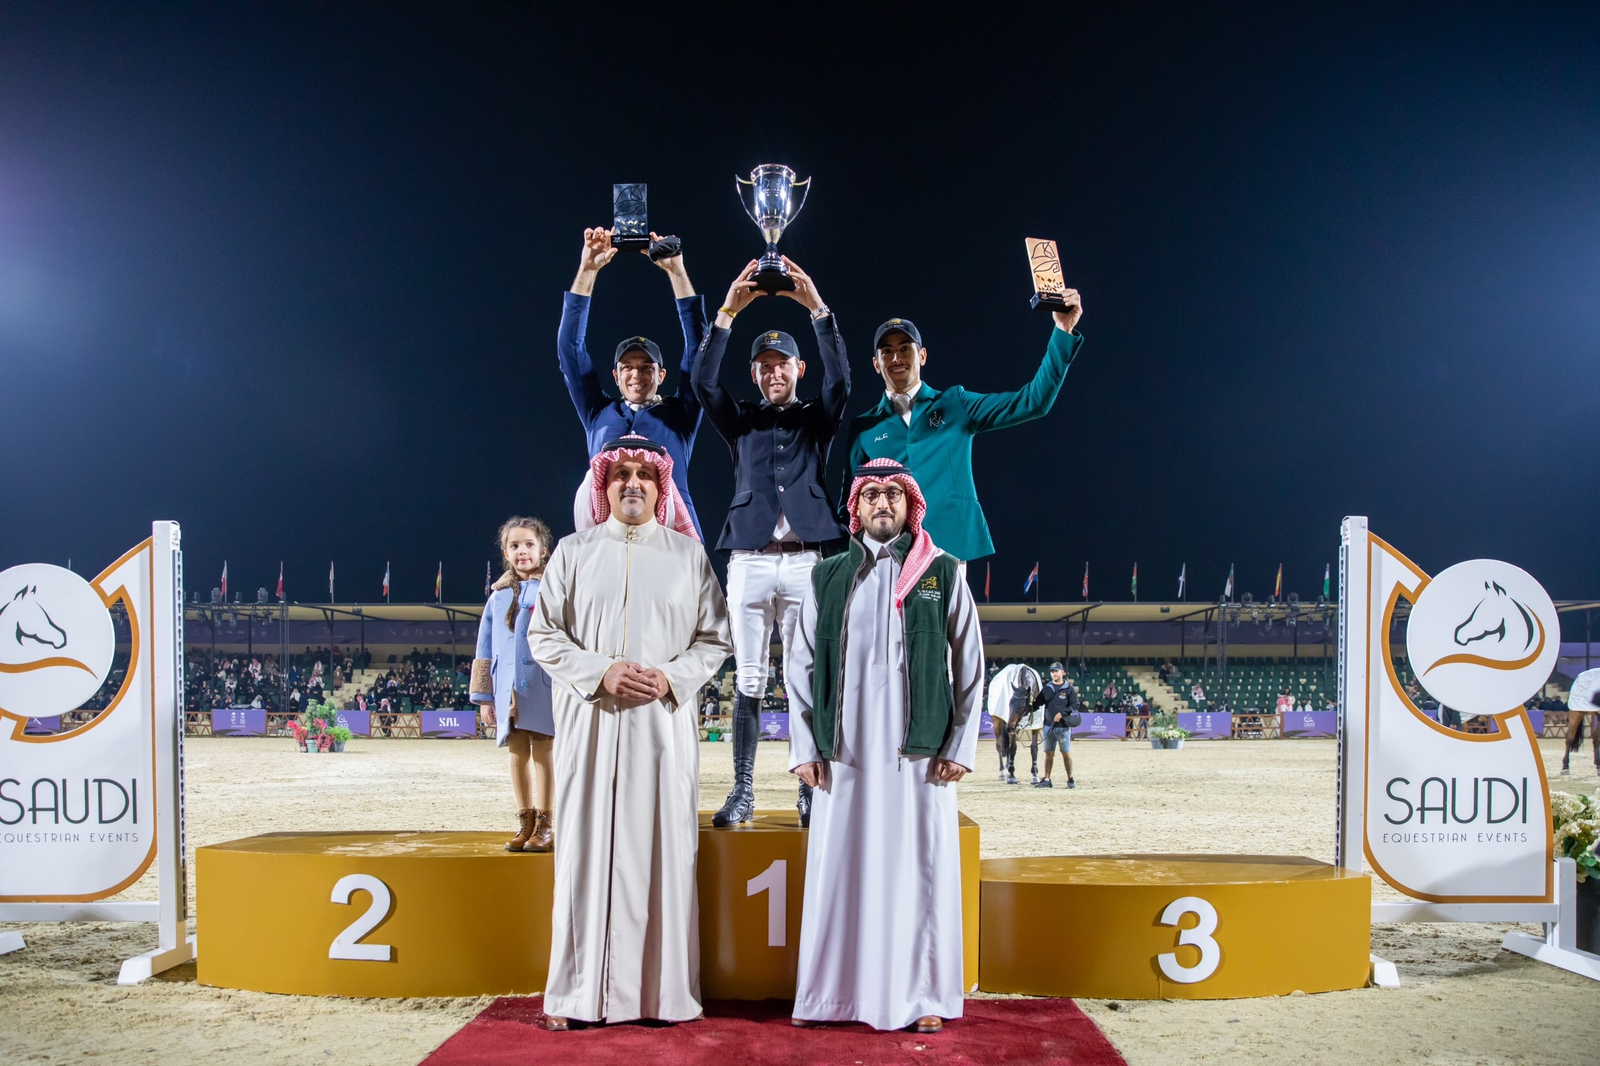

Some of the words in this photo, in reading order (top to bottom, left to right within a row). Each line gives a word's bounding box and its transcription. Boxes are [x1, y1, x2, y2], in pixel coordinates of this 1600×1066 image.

[439, 717, 460, 727] SAL
[0, 778, 138, 825] SAUDI
[1383, 777, 1528, 825] SAUDI
[0, 832, 80, 843] QUESTRIAN
[90, 832, 139, 843] EVENTS
[1383, 832, 1468, 844] EQUESTRIAN
[1477, 832, 1528, 843] EVENTS
[328, 873, 391, 961] 2
[746, 859, 787, 947] 1
[1157, 896, 1221, 984] 3
